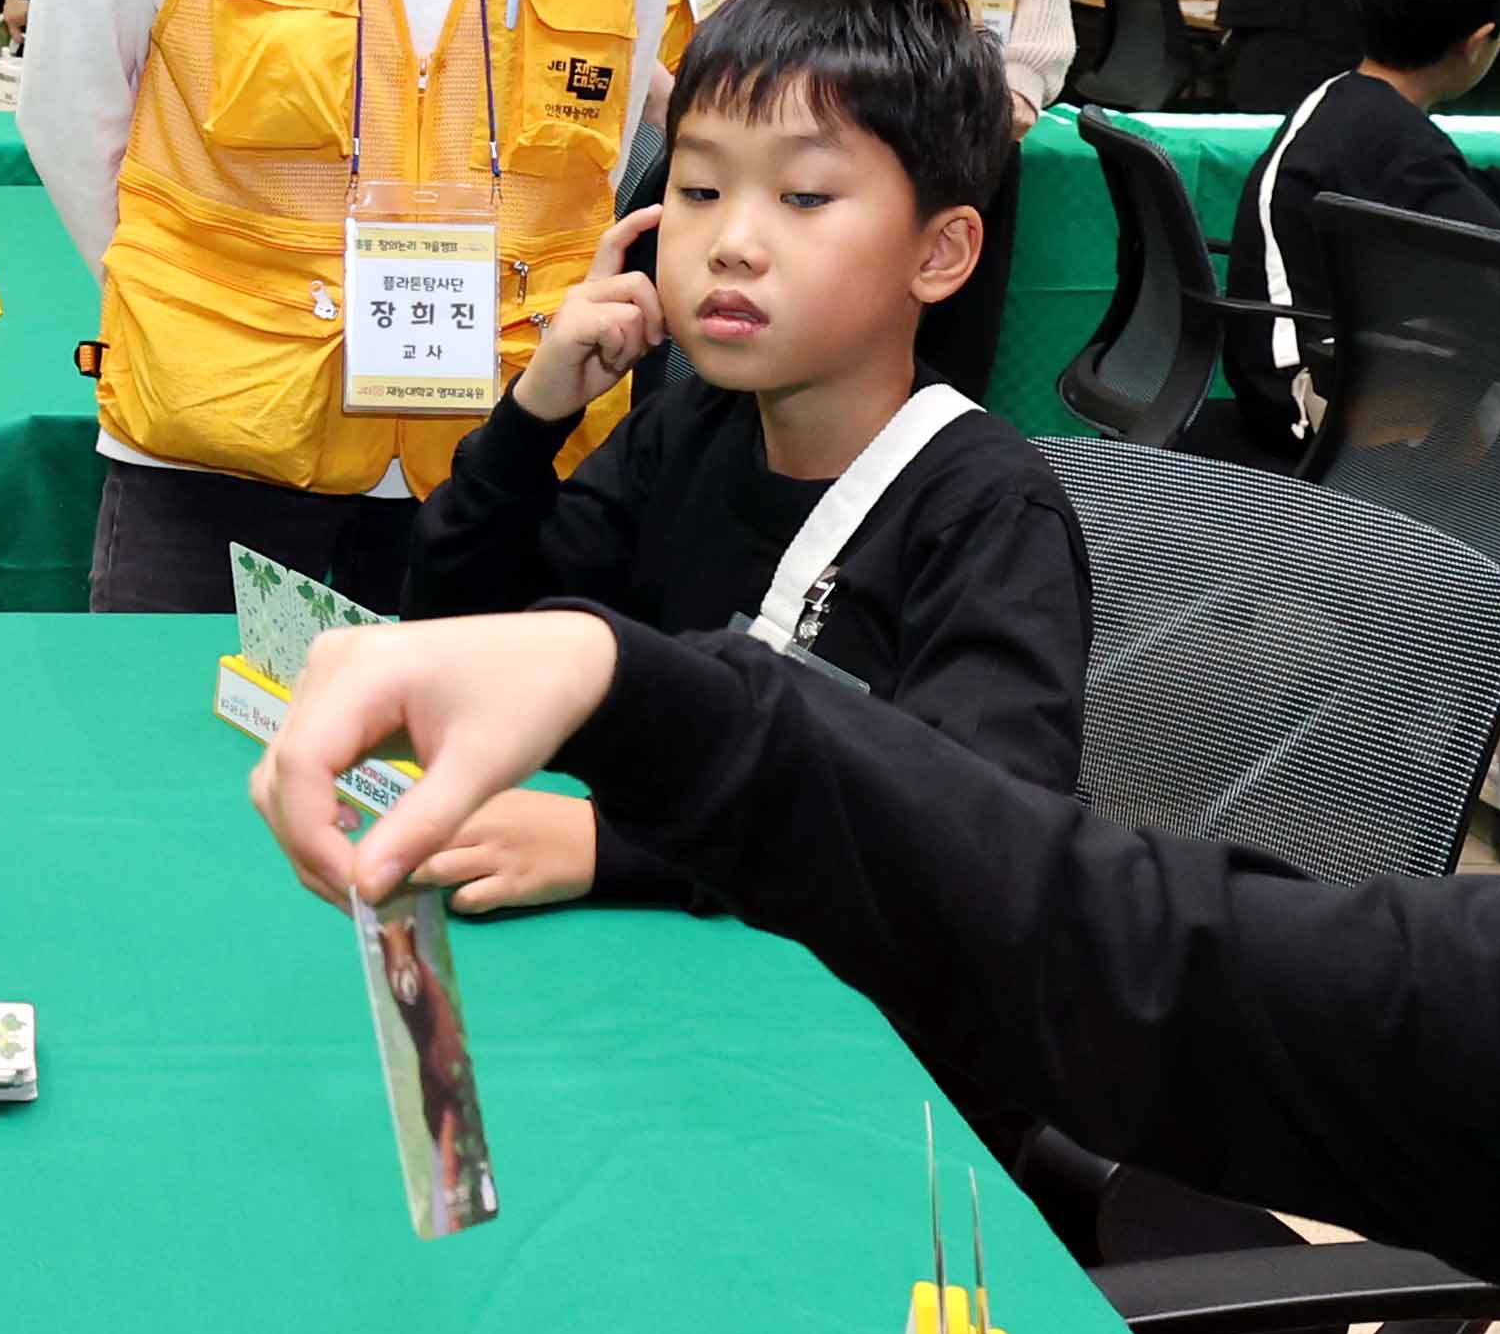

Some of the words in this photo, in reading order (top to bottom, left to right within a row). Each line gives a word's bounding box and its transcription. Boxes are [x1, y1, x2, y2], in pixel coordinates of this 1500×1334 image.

[547, 60, 567, 72] JEI
[383, 275, 464, 293] 플라톤탐사단
[386, 386, 435, 399] 재능대학교
[437, 386, 485, 400] 영재교육원
